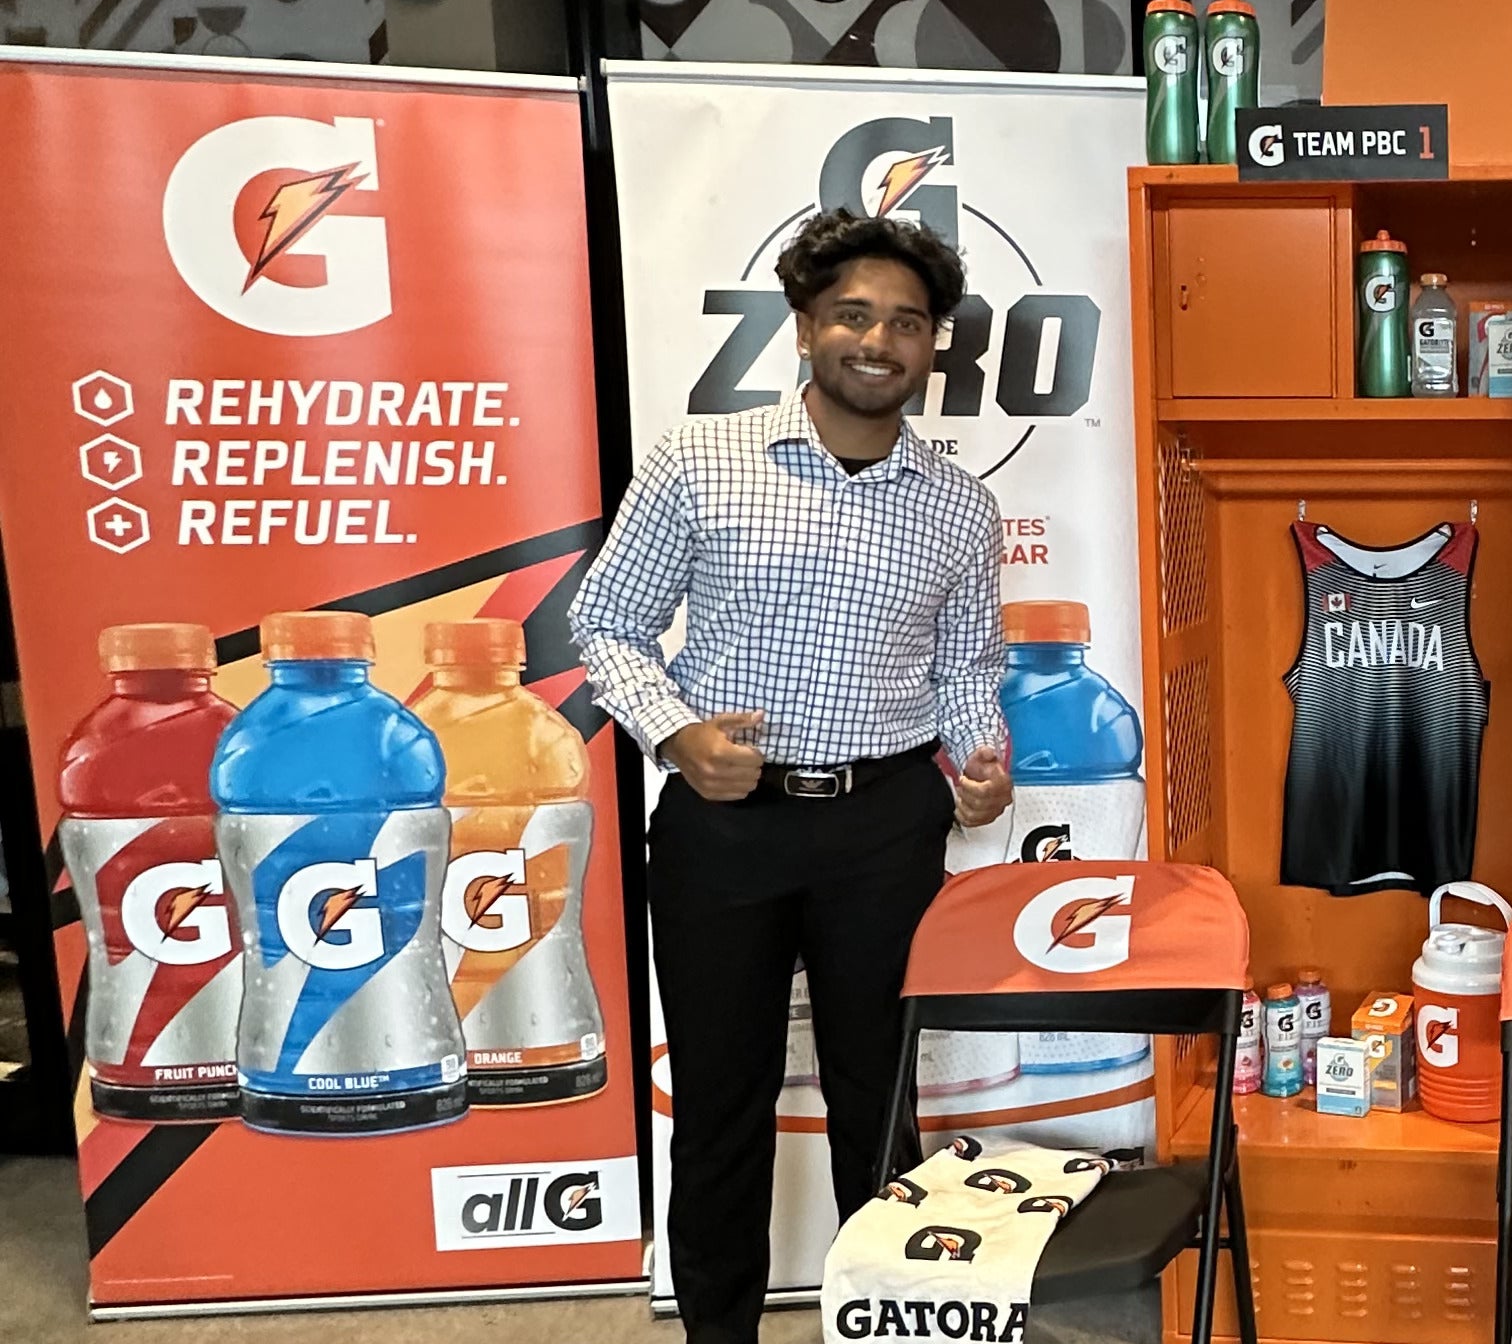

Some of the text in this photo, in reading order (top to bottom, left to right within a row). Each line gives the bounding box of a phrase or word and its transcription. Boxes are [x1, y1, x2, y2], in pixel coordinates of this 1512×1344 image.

[1154, 35, 1188, 75] G
[1212, 37, 1243, 76] G
[1249, 125, 1434, 167] G TEAM PBC 1
[163, 116, 392, 337] G
[1365, 275, 1396, 312] G
[1419, 321, 1434, 337] G
[687, 290, 1102, 416] ZRO
[165, 379, 521, 427] REHYDRATE.
[171, 440, 508, 486] REPLENISH.
[178, 499, 418, 545] REFUEL.
[1324, 620, 1443, 671] CANADA
[121, 858, 232, 965] G
[277, 857, 385, 970] G
[441, 848, 532, 952] G
[1013, 875, 1135, 973] G
[1278, 1014, 1293, 1032] G
[1306, 1002, 1321, 1019] G
[474, 1051, 523, 1064] ORANGE
[1416, 1004, 1459, 1068] G
[155, 1066, 195, 1081] FRUIT
[308, 1077, 342, 1090] COOL
[1325, 1064, 1353, 1078] ZERO
